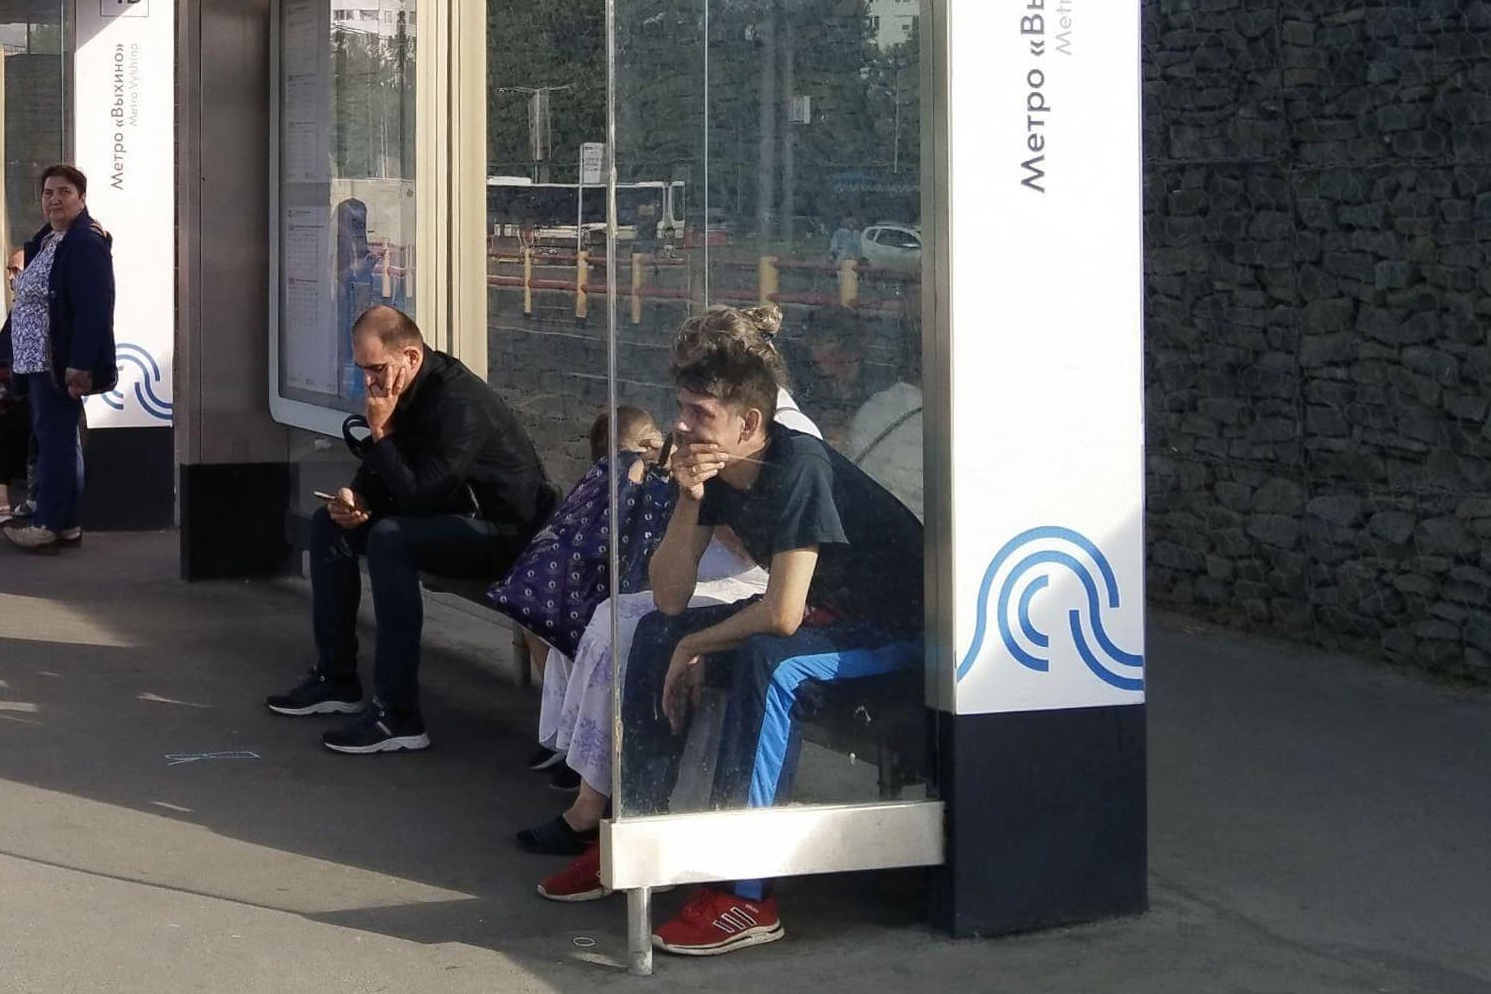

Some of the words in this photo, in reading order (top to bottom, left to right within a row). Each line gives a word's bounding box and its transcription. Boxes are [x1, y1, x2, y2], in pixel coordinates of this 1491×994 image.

[110, 44, 125, 127] «Выхино»
[129, 93, 139, 127] Metro
[110, 132, 127, 190] Метро
[1020, 68, 1051, 194] Метро
